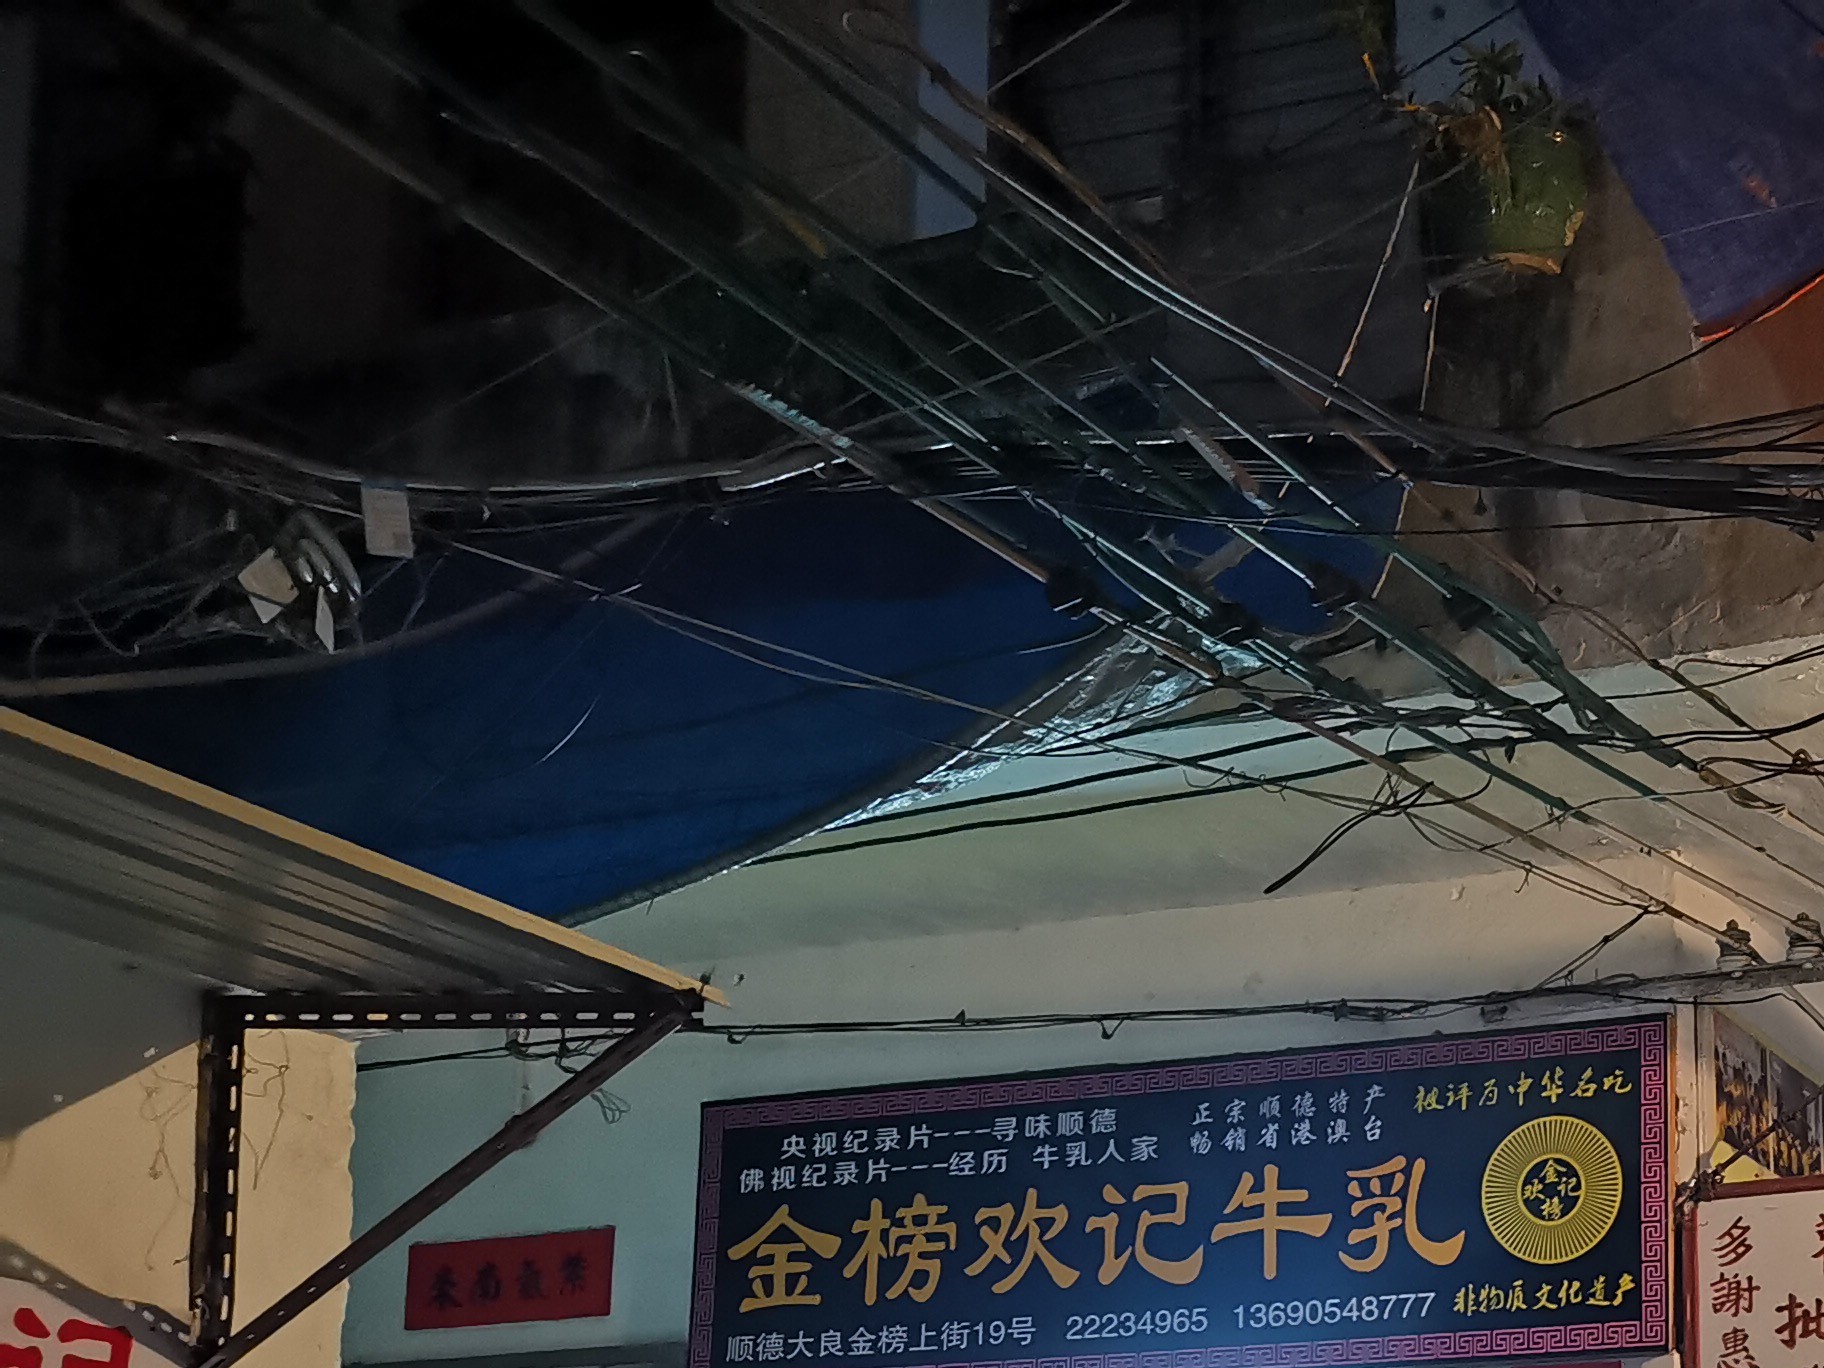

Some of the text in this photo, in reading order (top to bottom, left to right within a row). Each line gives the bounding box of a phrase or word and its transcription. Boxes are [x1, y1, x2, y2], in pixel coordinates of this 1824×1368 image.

[1190, 1084, 1385, 1126] 正宗顺德特产
[1414, 1065, 1634, 1114] 被评为中华名吃
[1032, 1135, 1160, 1170] 牛乳人家
[1189, 1115, 1384, 1156] 畅销省港澳台
[726, 1155, 1466, 1313] 金榜欢记牛乳
[1453, 1272, 1636, 1315] 非物质文化遗产
[726, 1292, 1435, 1364] 顺德大良金榜上街19号 22234965 13690548777
